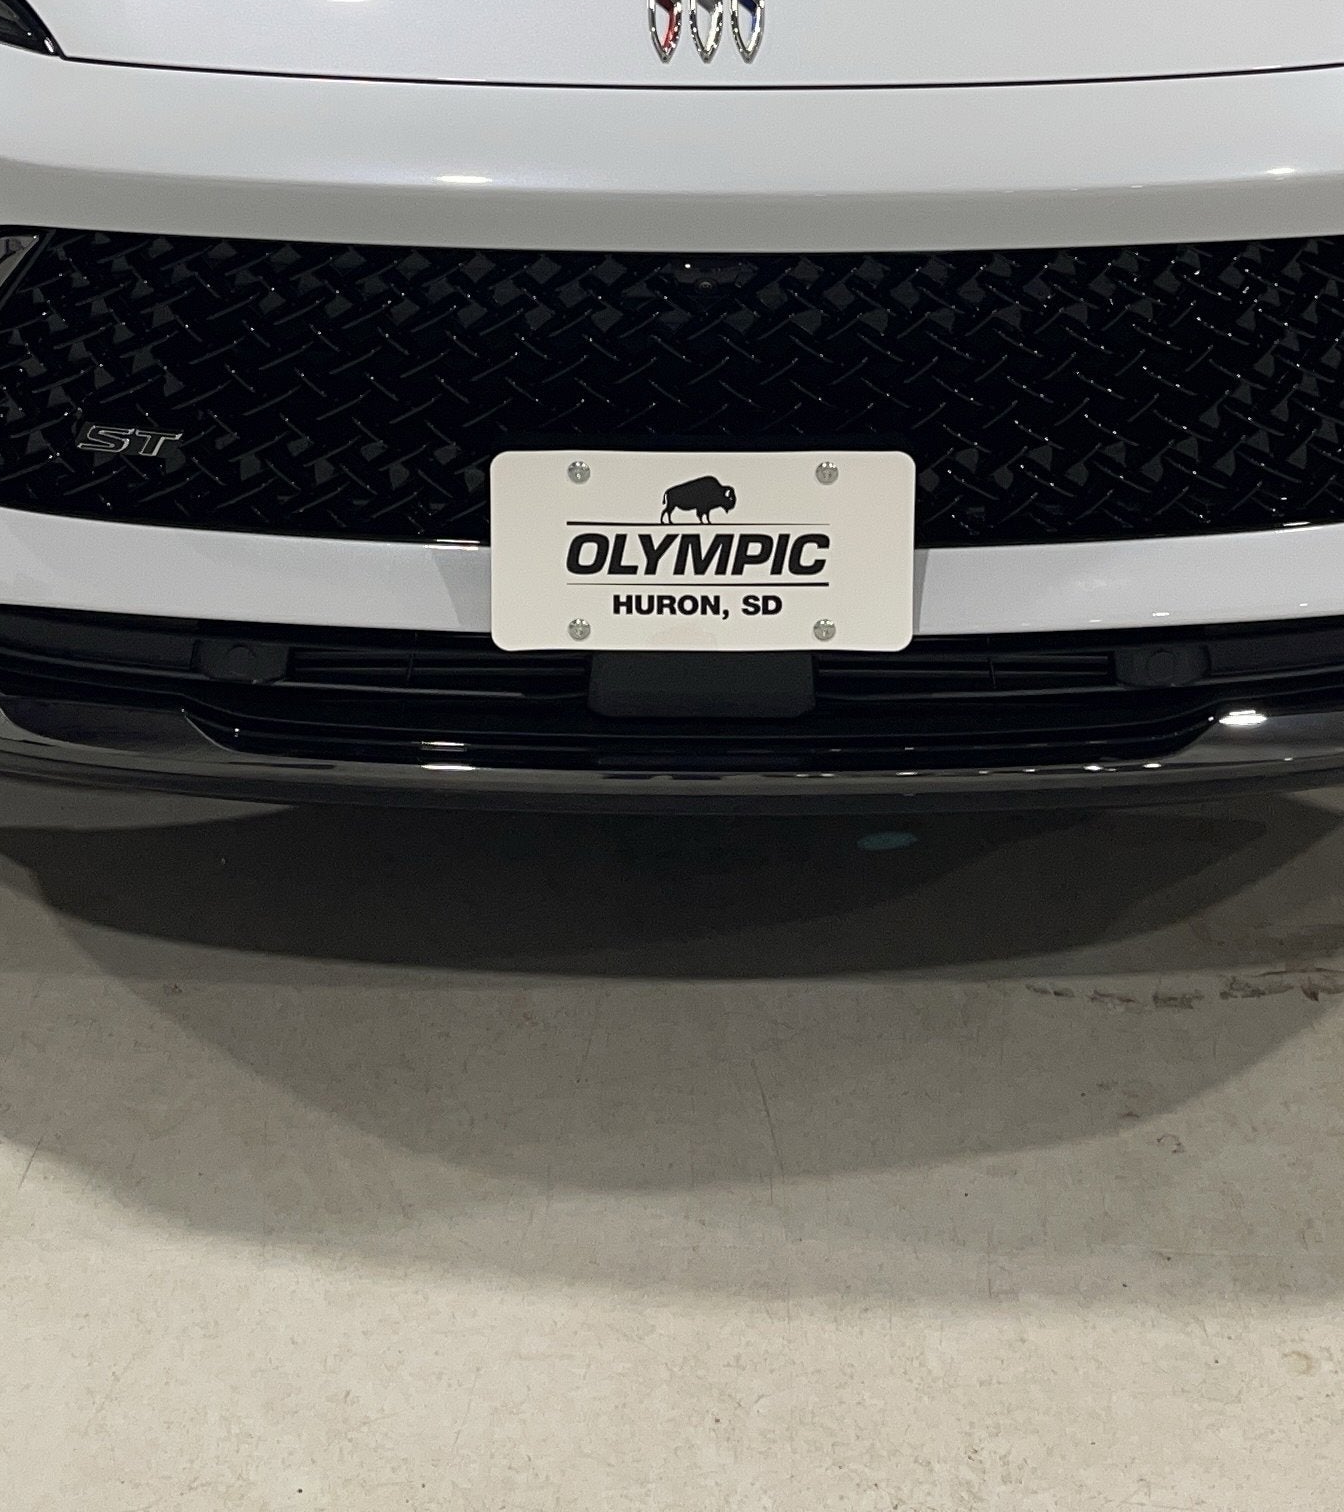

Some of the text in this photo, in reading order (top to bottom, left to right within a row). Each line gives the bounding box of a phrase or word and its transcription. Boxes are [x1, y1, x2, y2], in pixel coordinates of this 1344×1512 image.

[76, 424, 183, 457] ST
[566, 532, 830, 577] OLYMPIC
[613, 594, 783, 620] HURON, SD
